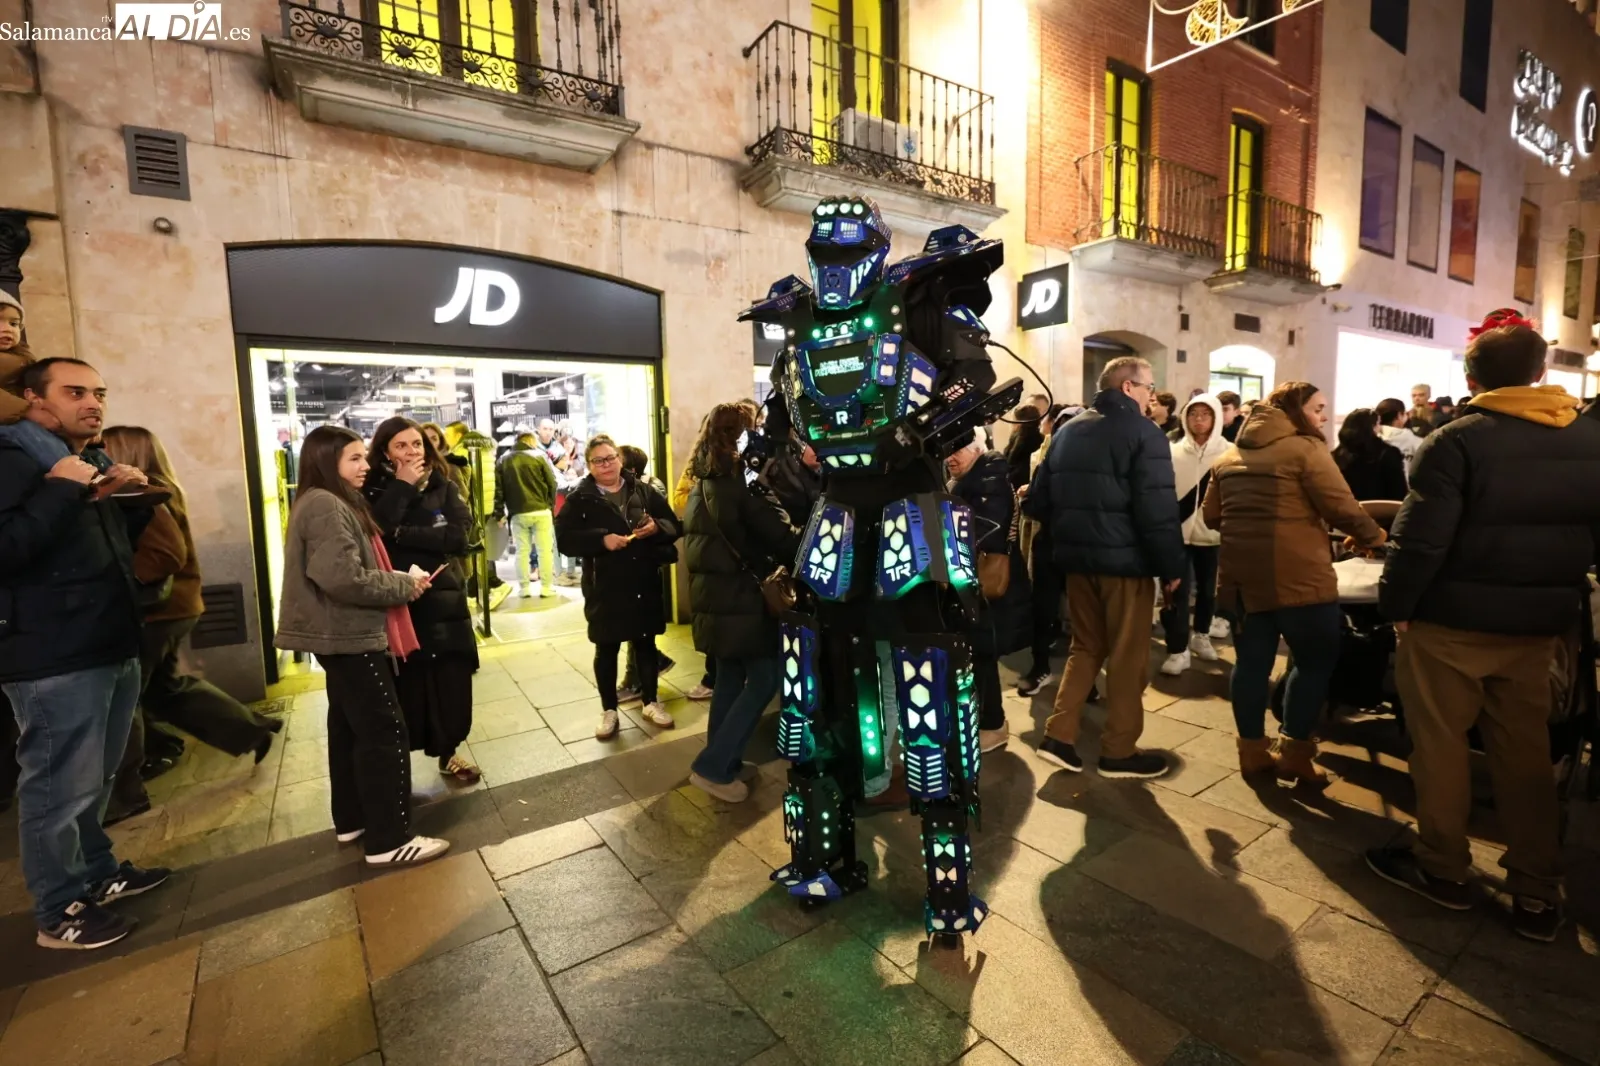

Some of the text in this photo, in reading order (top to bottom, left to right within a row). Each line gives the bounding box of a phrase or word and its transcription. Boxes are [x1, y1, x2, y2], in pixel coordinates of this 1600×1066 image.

[434, 266, 521, 326] JD
[1021, 278, 1060, 318] JD
[492, 403, 526, 417] HOMBRE
[835, 410, 848, 425] R
